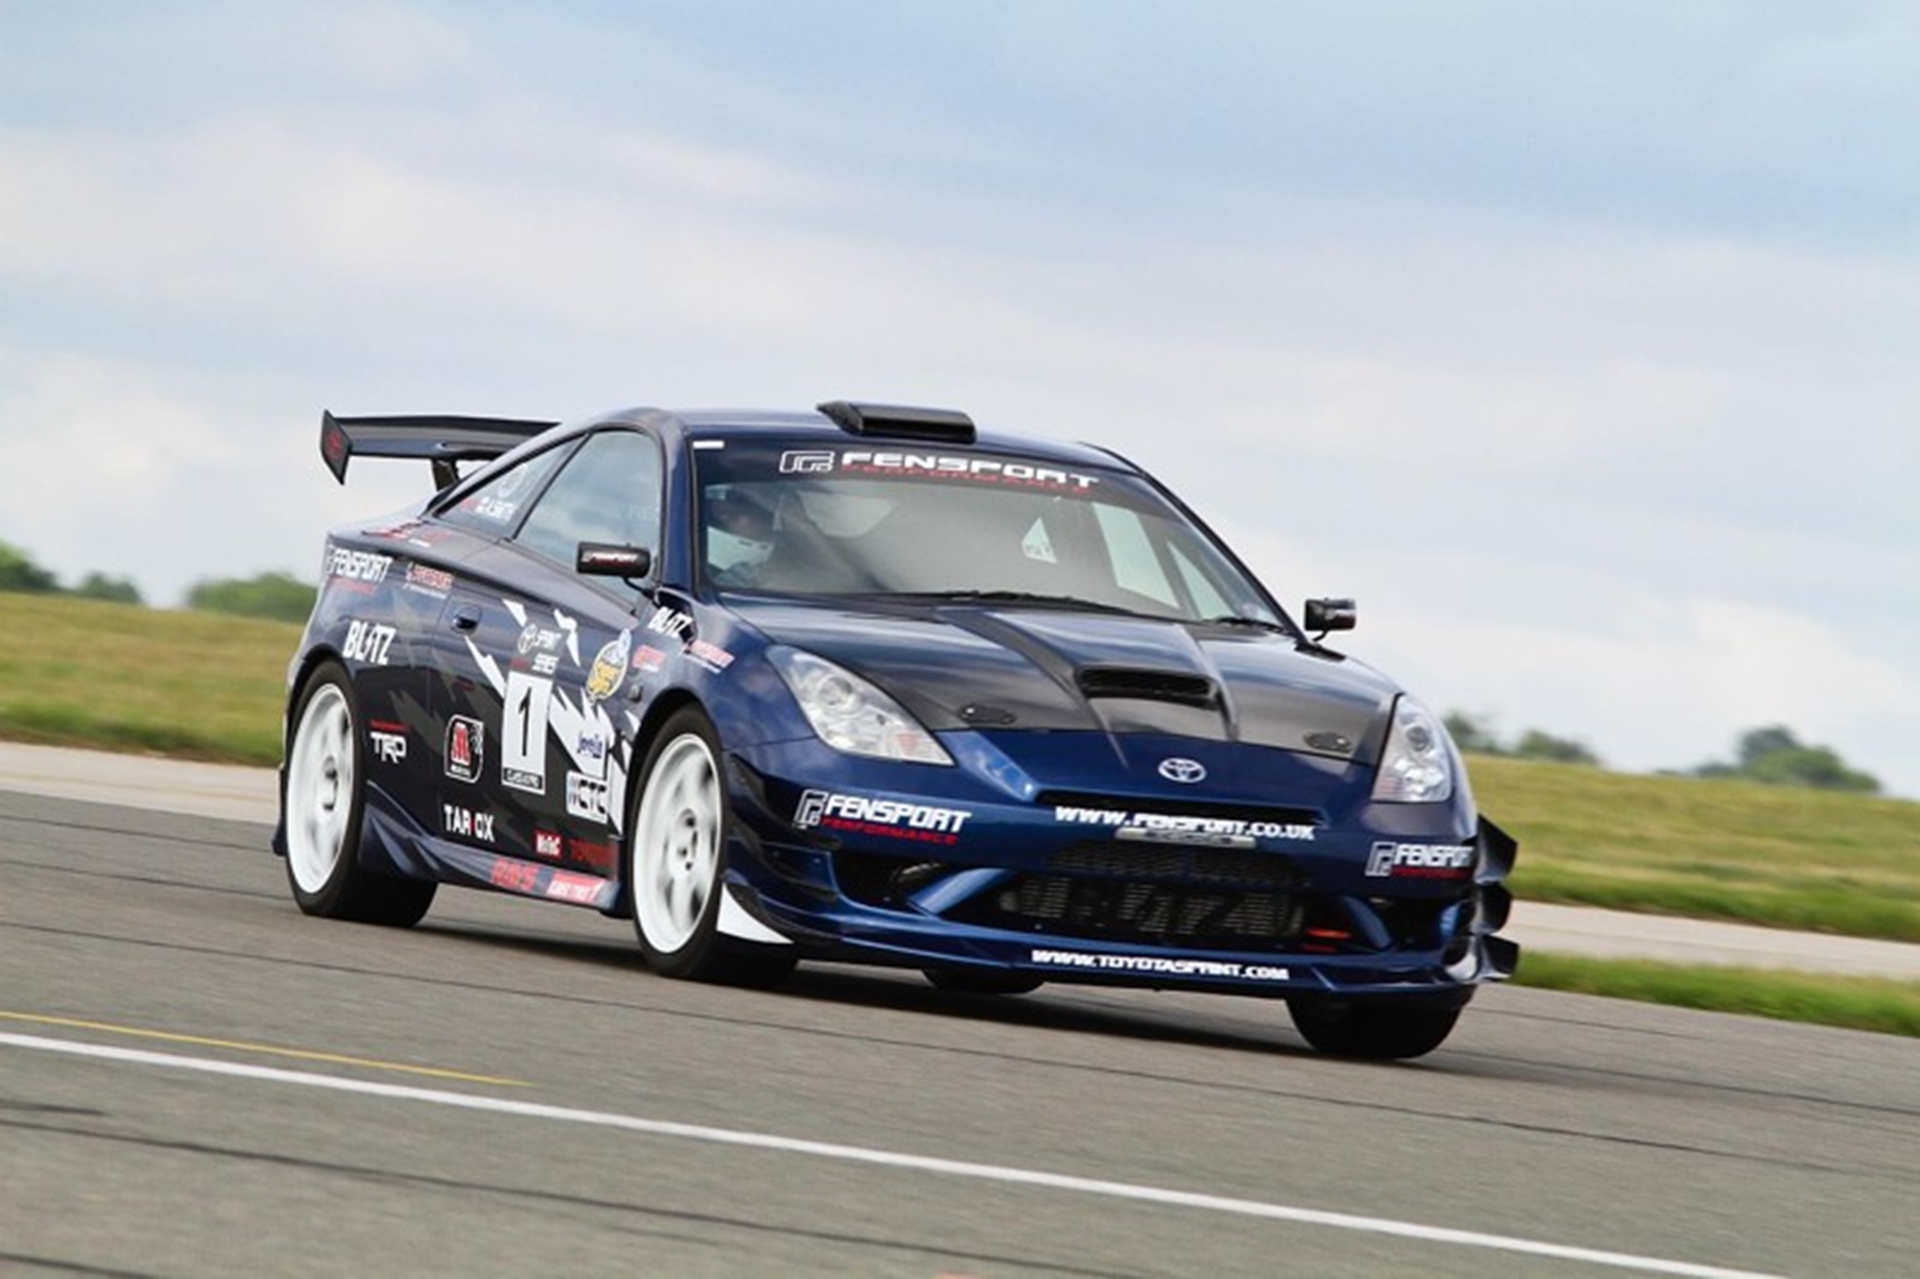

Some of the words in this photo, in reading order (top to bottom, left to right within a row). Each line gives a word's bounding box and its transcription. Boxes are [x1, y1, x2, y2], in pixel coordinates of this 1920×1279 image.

[842, 451, 1099, 479] FENSPORT
[342, 620, 397, 666] BLITZ
[519, 686, 532, 757] 1
[370, 731, 407, 764] TRD
[825, 793, 973, 833] FENSPORT
